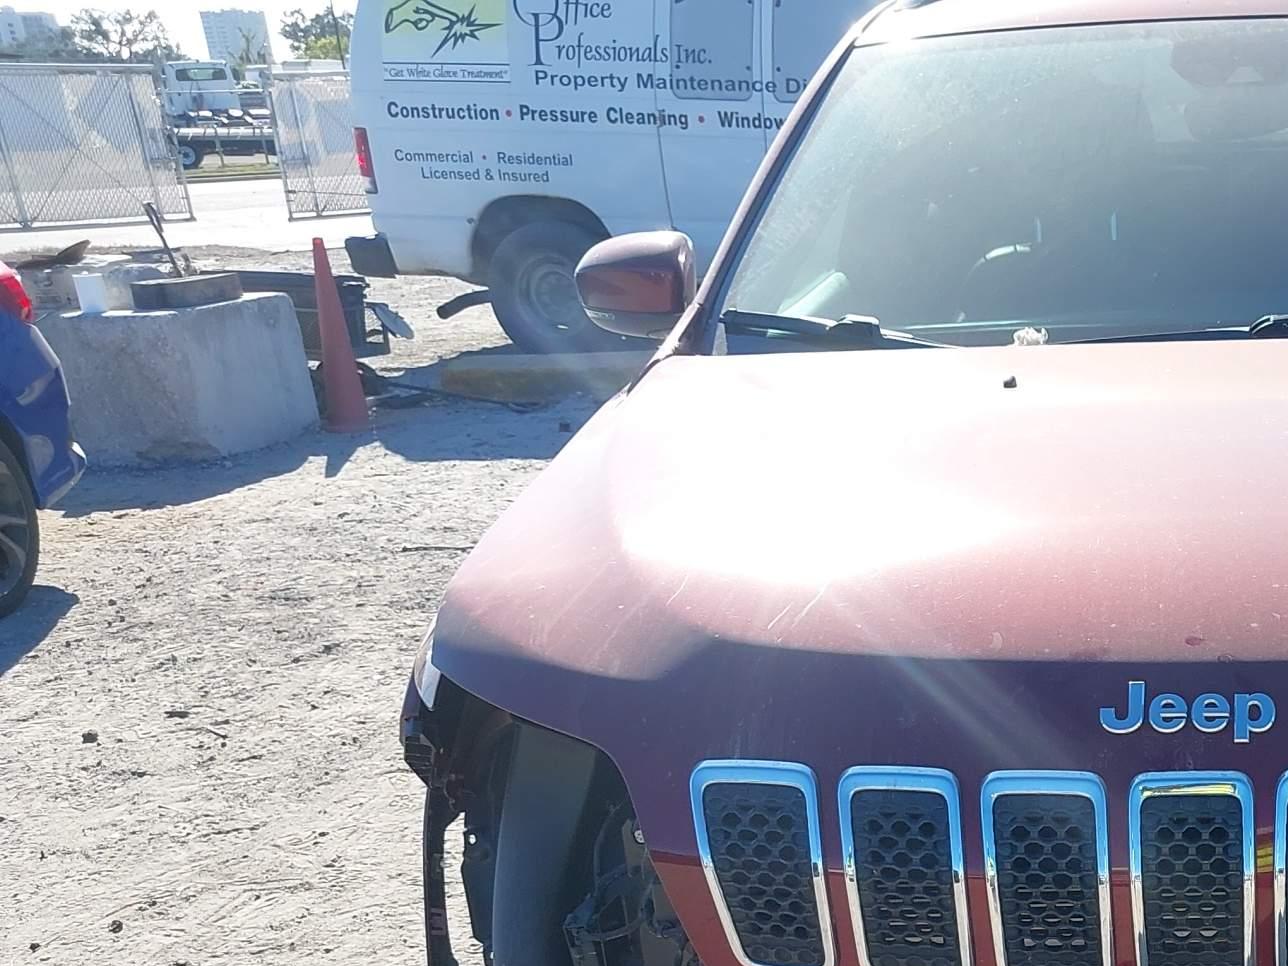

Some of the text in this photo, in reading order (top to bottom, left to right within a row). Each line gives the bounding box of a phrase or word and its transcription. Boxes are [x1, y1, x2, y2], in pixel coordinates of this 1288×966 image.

[527, 12, 713, 68] Professionals Inc.
[535, 70, 628, 92] Property
[636, 73, 777, 93] Maintenance
[387, 101, 500, 121] Construction
[519, 104, 598, 123] Pressure
[606, 106, 689, 129] Cleaning
[394, 149, 573, 166] Commercial Residential
[421, 167, 550, 183] Licensed & Insured
[1099, 681, 1276, 744] Jeep
